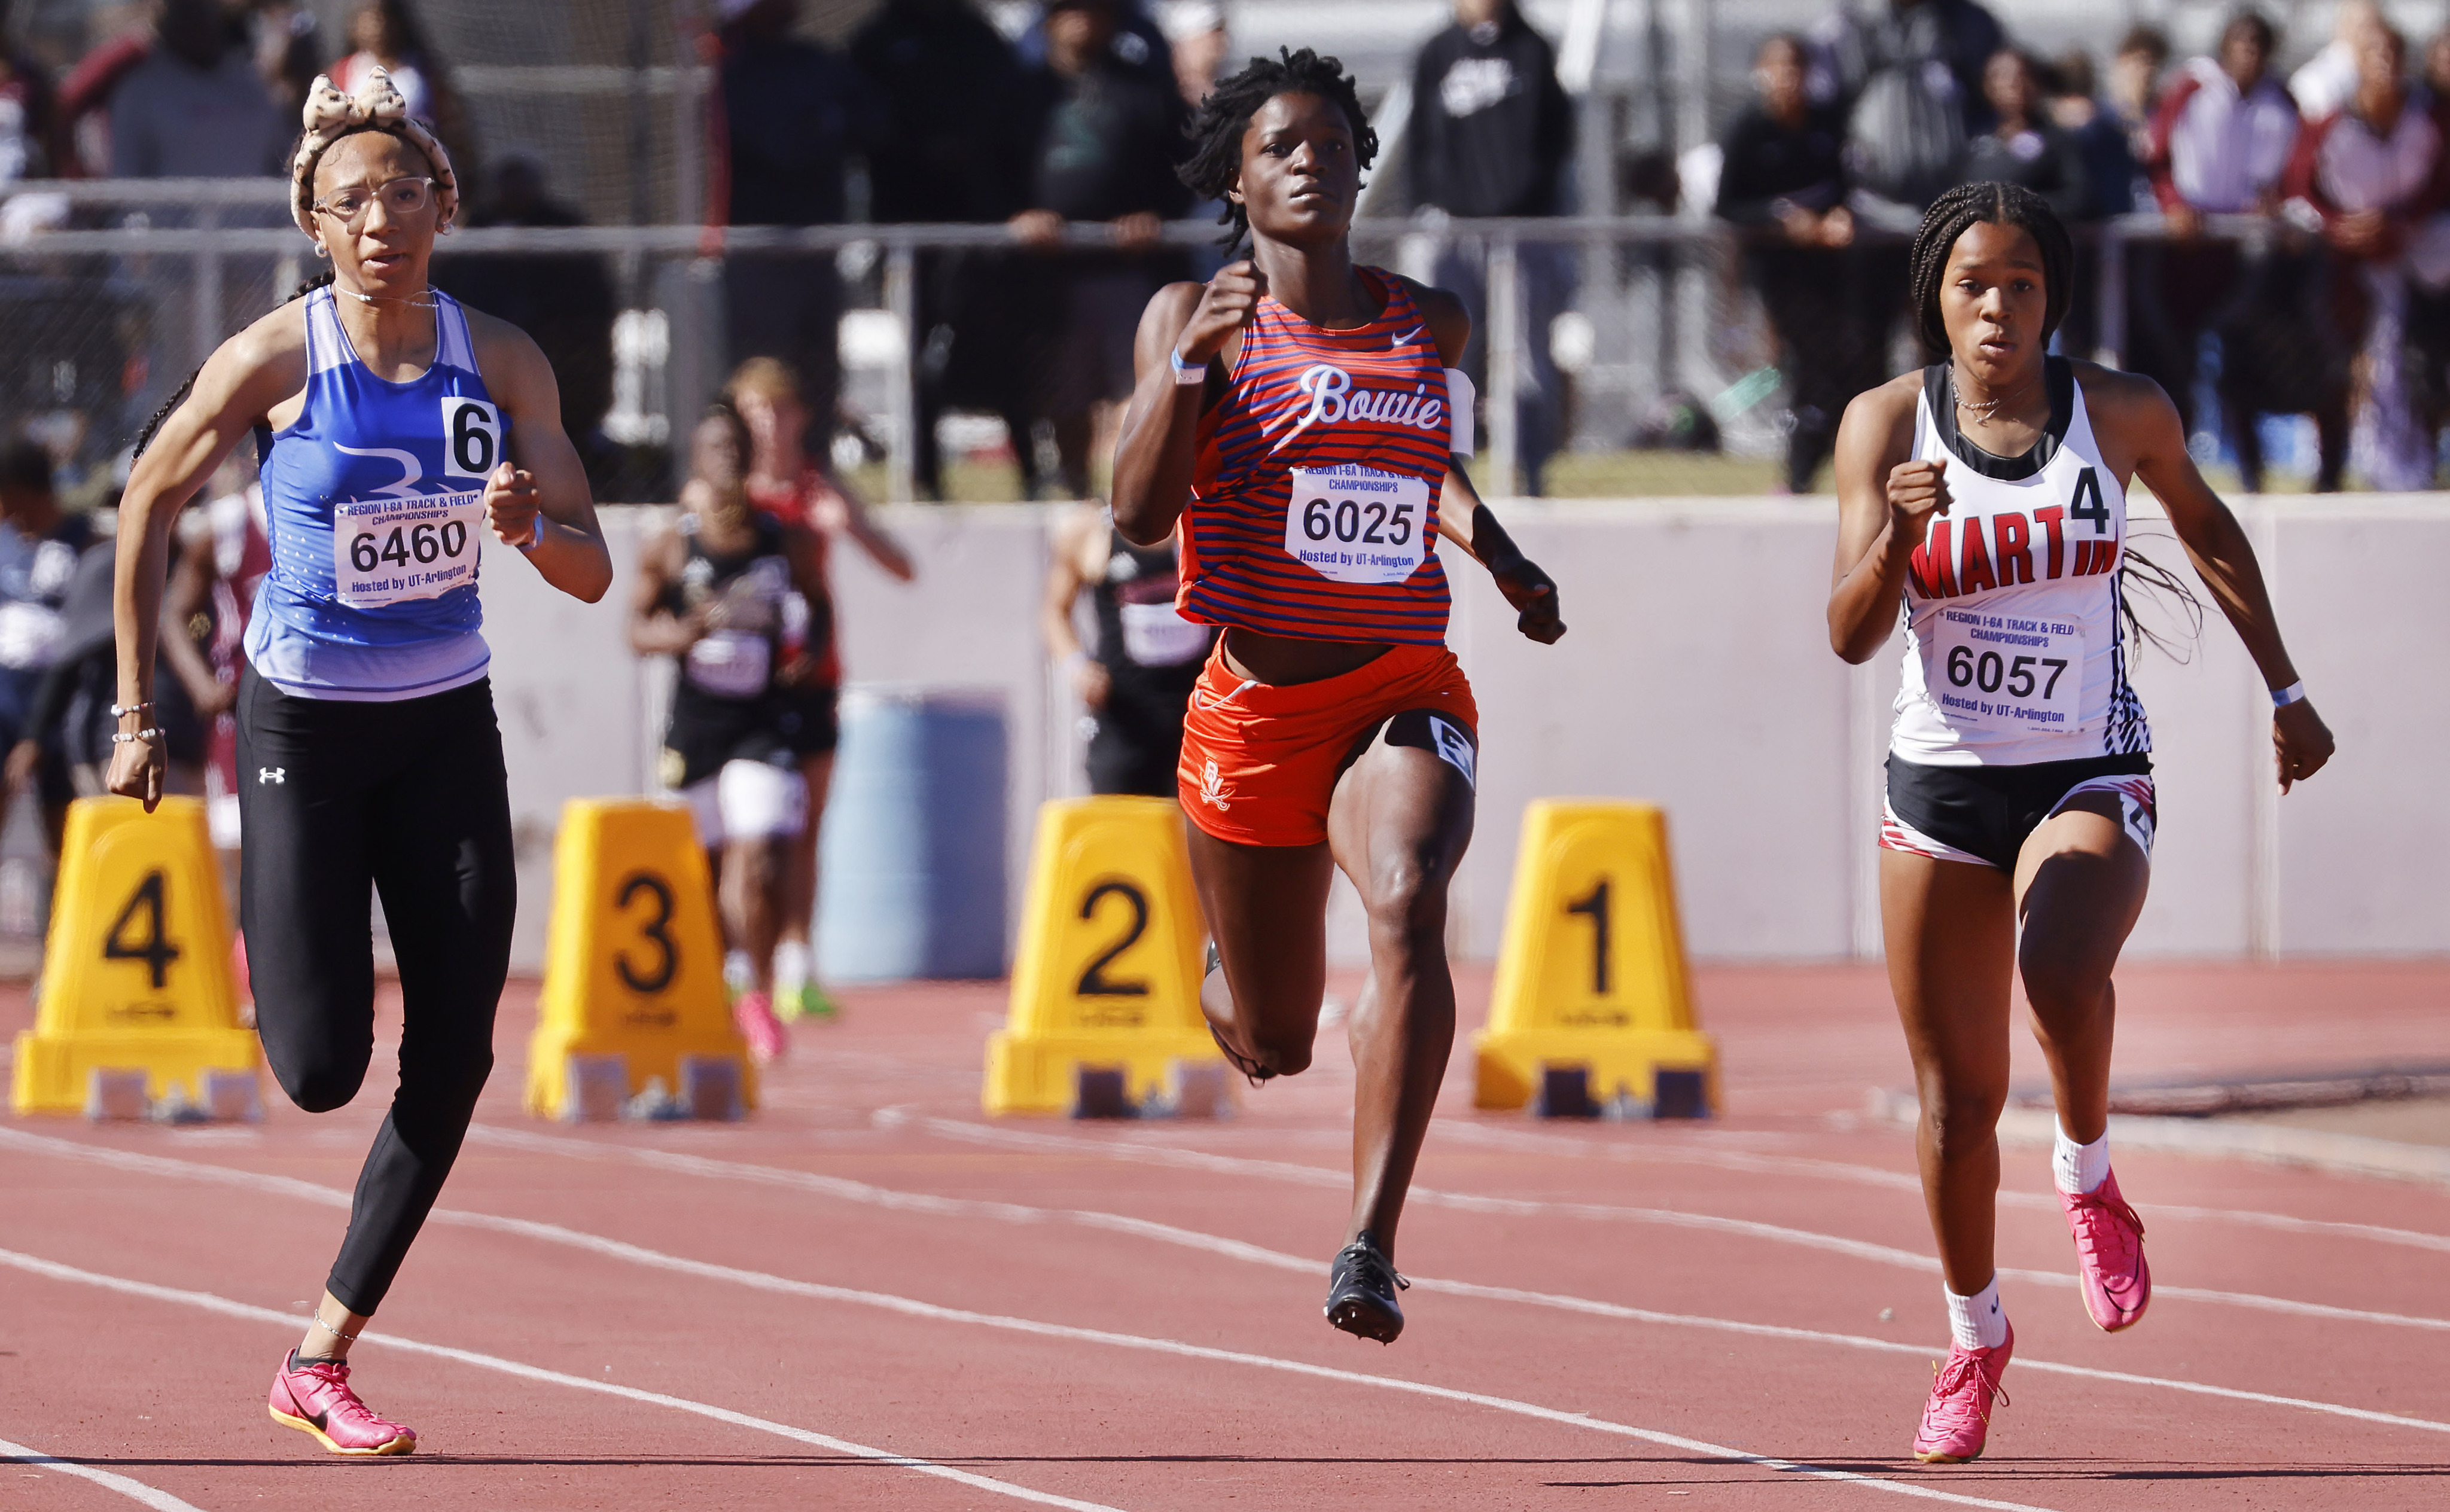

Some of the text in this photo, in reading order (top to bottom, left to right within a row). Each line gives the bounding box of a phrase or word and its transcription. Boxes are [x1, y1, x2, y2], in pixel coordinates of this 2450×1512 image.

[1297, 364, 1442, 429] Bowie
[453, 403, 494, 473] 6
[1329, 479, 1398, 493] CHAMPIONSHIPS
[1360, 466, 1386, 478] TRACK
[348, 502, 382, 516] REGION
[406, 496, 436, 510] TRACK
[439, 496, 448, 508] &
[450, 494, 474, 507] FIELD
[371, 509, 449, 526] CHAMPIONSHIPS
[1303, 498, 1414, 545] 6025
[2070, 465, 2110, 534] 4
[351, 520, 467, 572] 6460
[1299, 549, 1415, 568] Hosted by UT-Arlington
[352, 578, 389, 593] Hosted
[392, 578, 406, 590] by
[407, 564, 467, 588] UT-Arlington
[1946, 610, 1981, 626] REGION
[2006, 618, 2038, 633] TRACK
[2040, 623, 2049, 633] &
[2050, 623, 2075, 636] FIELD
[1970, 627, 2050, 648] CHAMPIONSHIPS
[1947, 645, 2068, 700] 6057
[1942, 692, 1978, 711] Hosted
[1980, 701, 1994, 715] by
[1996, 703, 2065, 723] UT-Arlington
[104, 870, 181, 990] 4
[614, 873, 677, 993] 3
[1077, 880, 1150, 995] 2
[1566, 879, 1609, 994] 1
